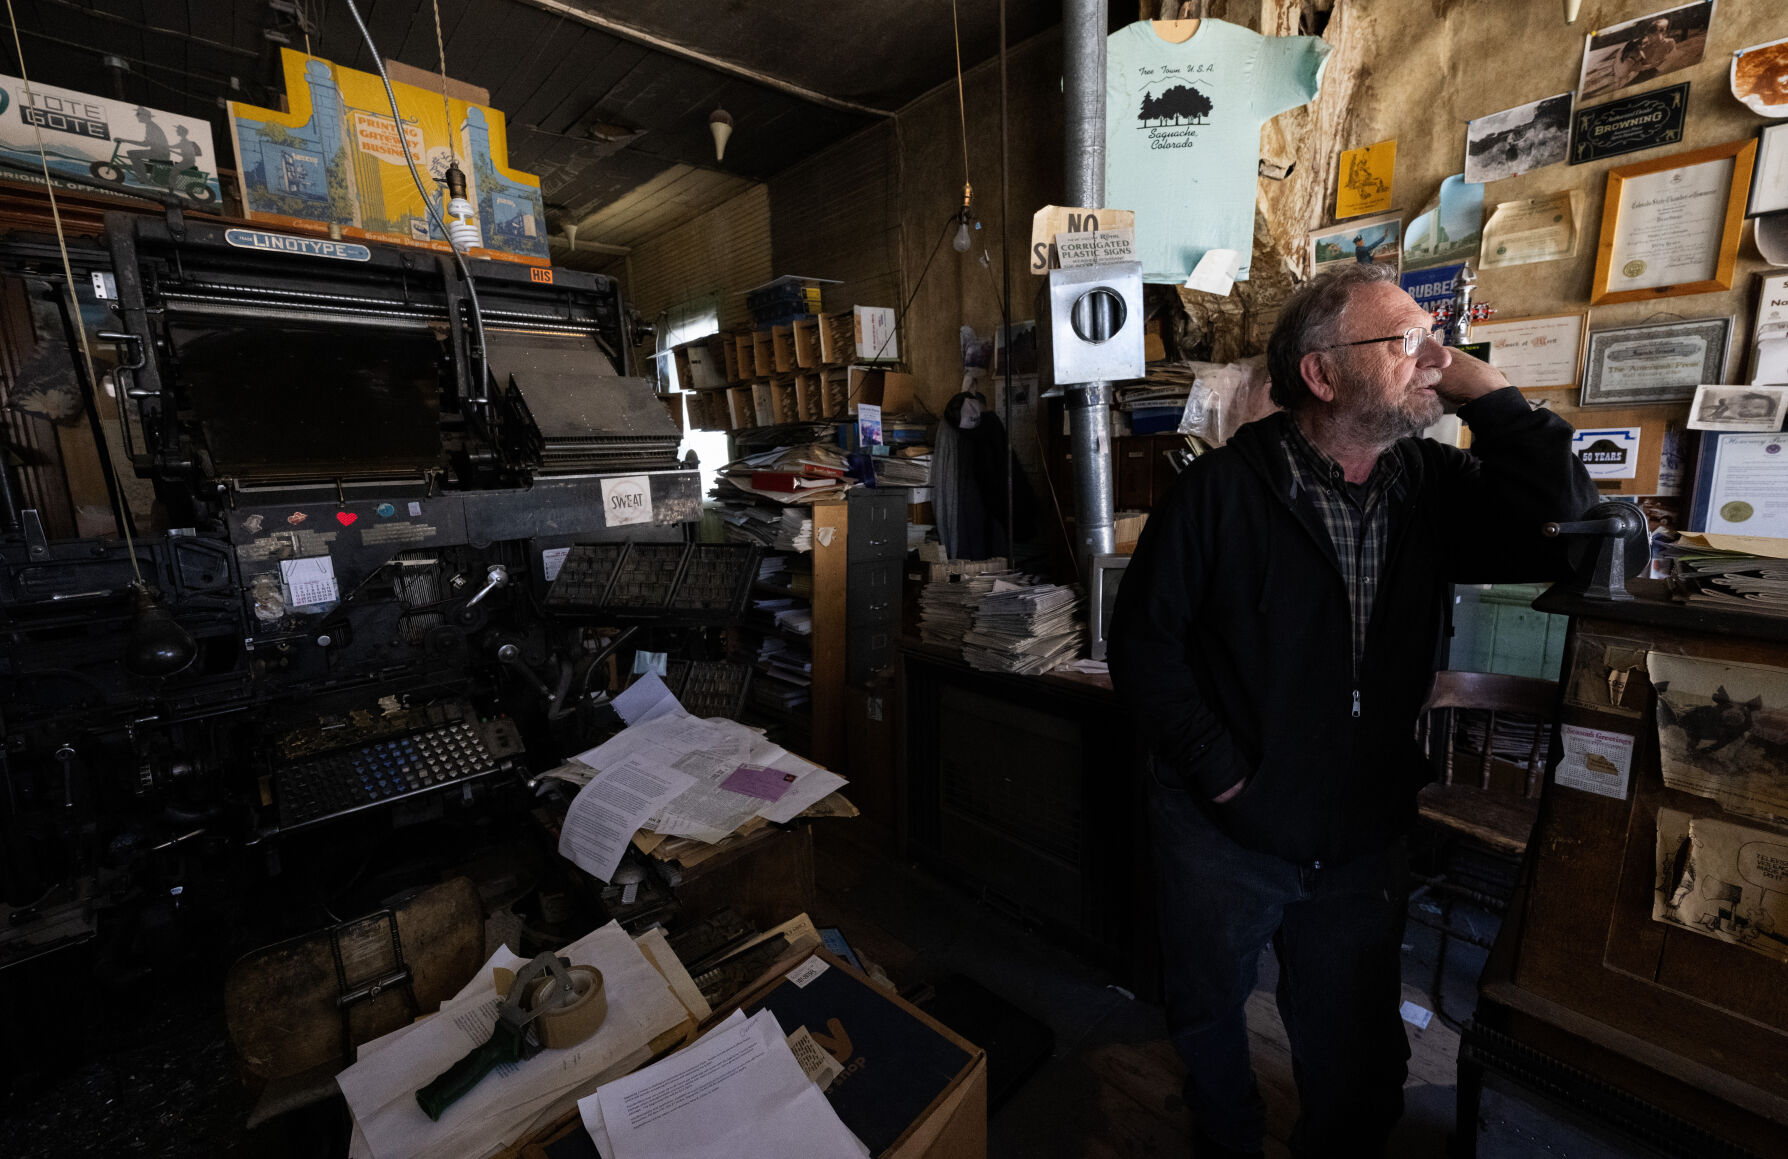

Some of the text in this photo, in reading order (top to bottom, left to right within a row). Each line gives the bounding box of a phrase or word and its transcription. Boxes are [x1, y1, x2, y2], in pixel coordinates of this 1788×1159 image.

[1139, 66, 1154, 76] Tree
[1161, 65, 1181, 74] Town
[22, 90, 101, 120] TOTE
[26, 109, 105, 138] GOTE
[1594, 111, 1663, 136] BROWNING
[1151, 137, 1193, 150] Colorado
[1068, 213, 1099, 234] NO
[253, 233, 348, 257] LINOTYPE
[1061, 239, 1130, 251] CORRUGATED
[1062, 247, 1132, 259] PLASTIC SIGNS
[532, 270, 551, 283] HIS
[1582, 451, 1623, 461] 50 YEARS
[611, 493, 643, 510] SWEAT
[1596, 732, 1632, 745] Greetings
